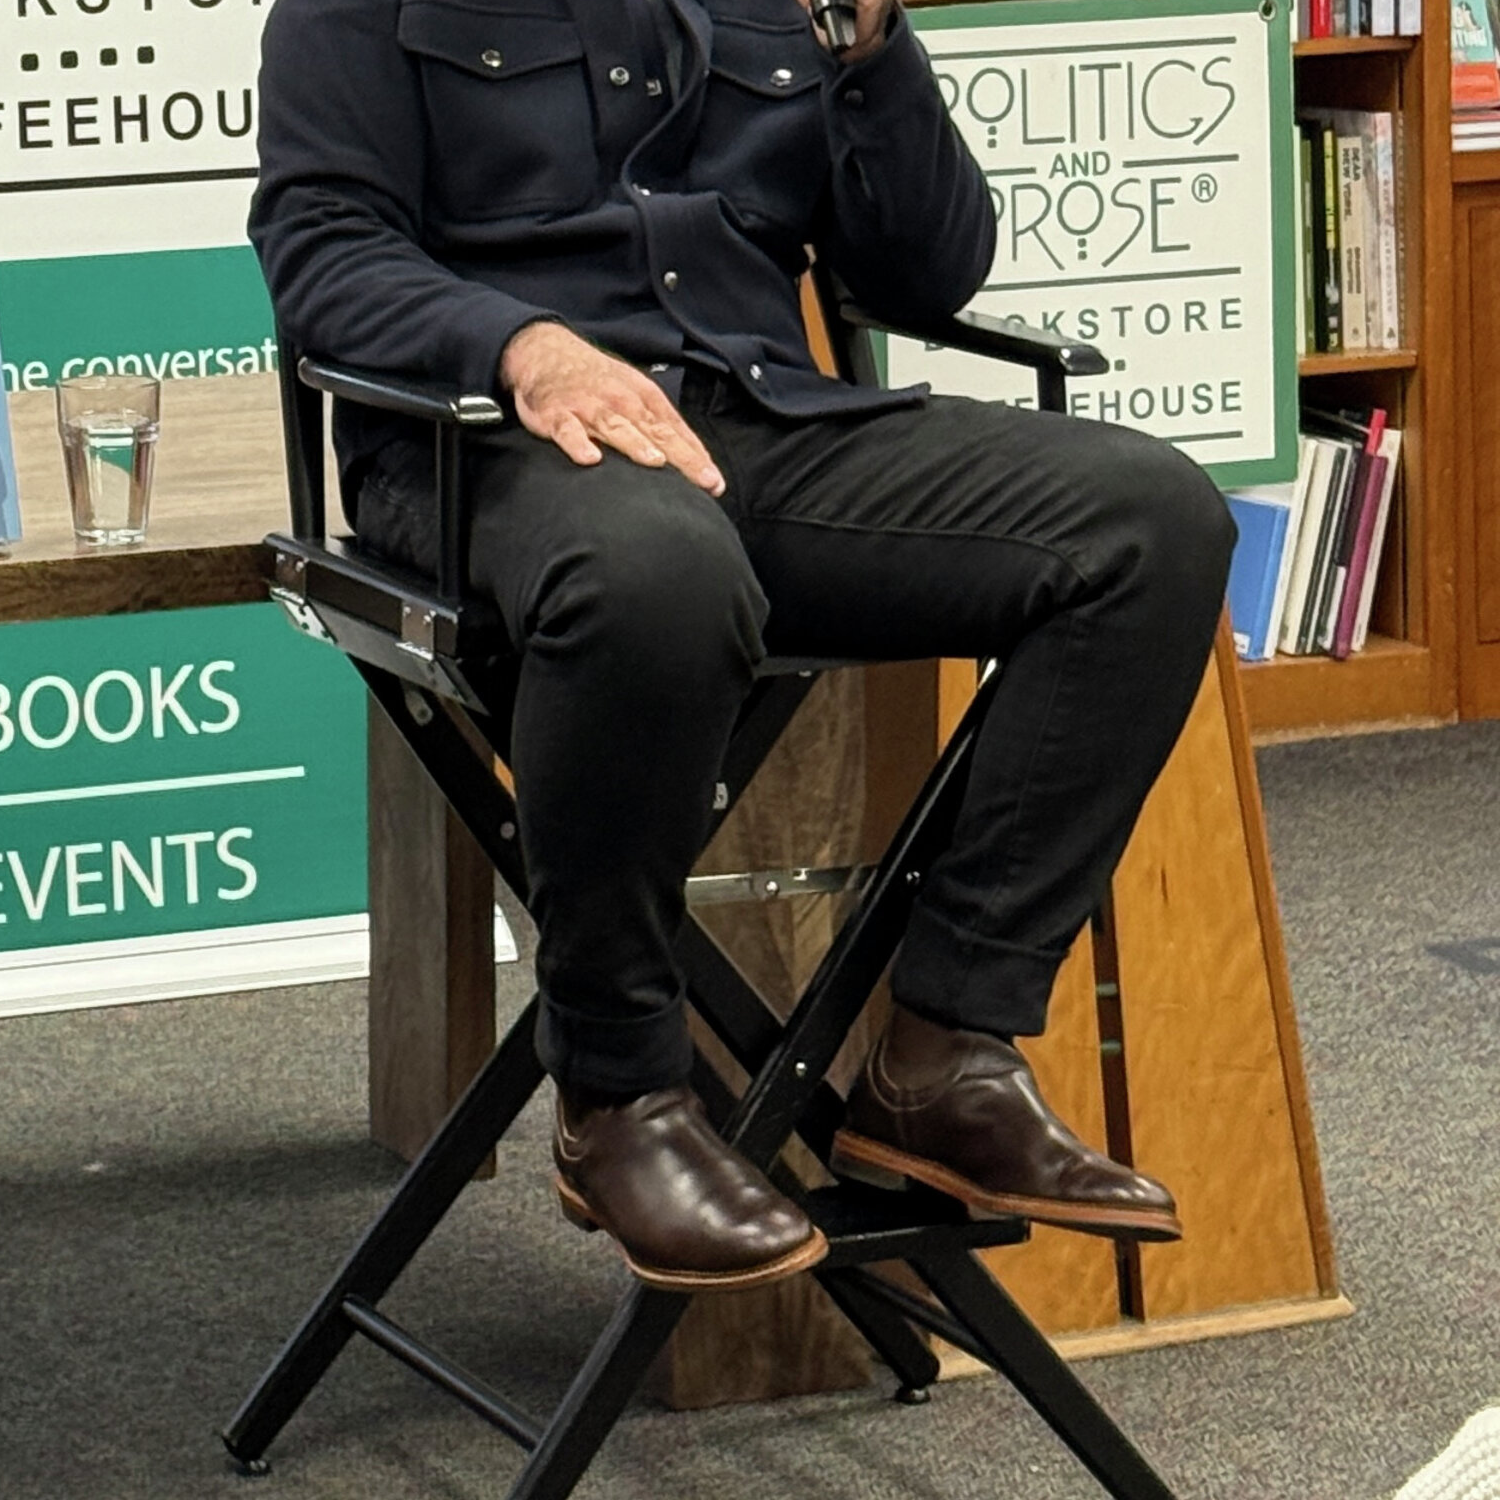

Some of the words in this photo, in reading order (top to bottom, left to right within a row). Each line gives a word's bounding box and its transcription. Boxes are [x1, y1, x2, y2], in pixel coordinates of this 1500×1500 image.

[1048, 151, 1111, 180] AND
[1004, 297, 1244, 339] KSTORE
[61, 337, 278, 384] conversat
[1014, 380, 1244, 421] EHOUSE
